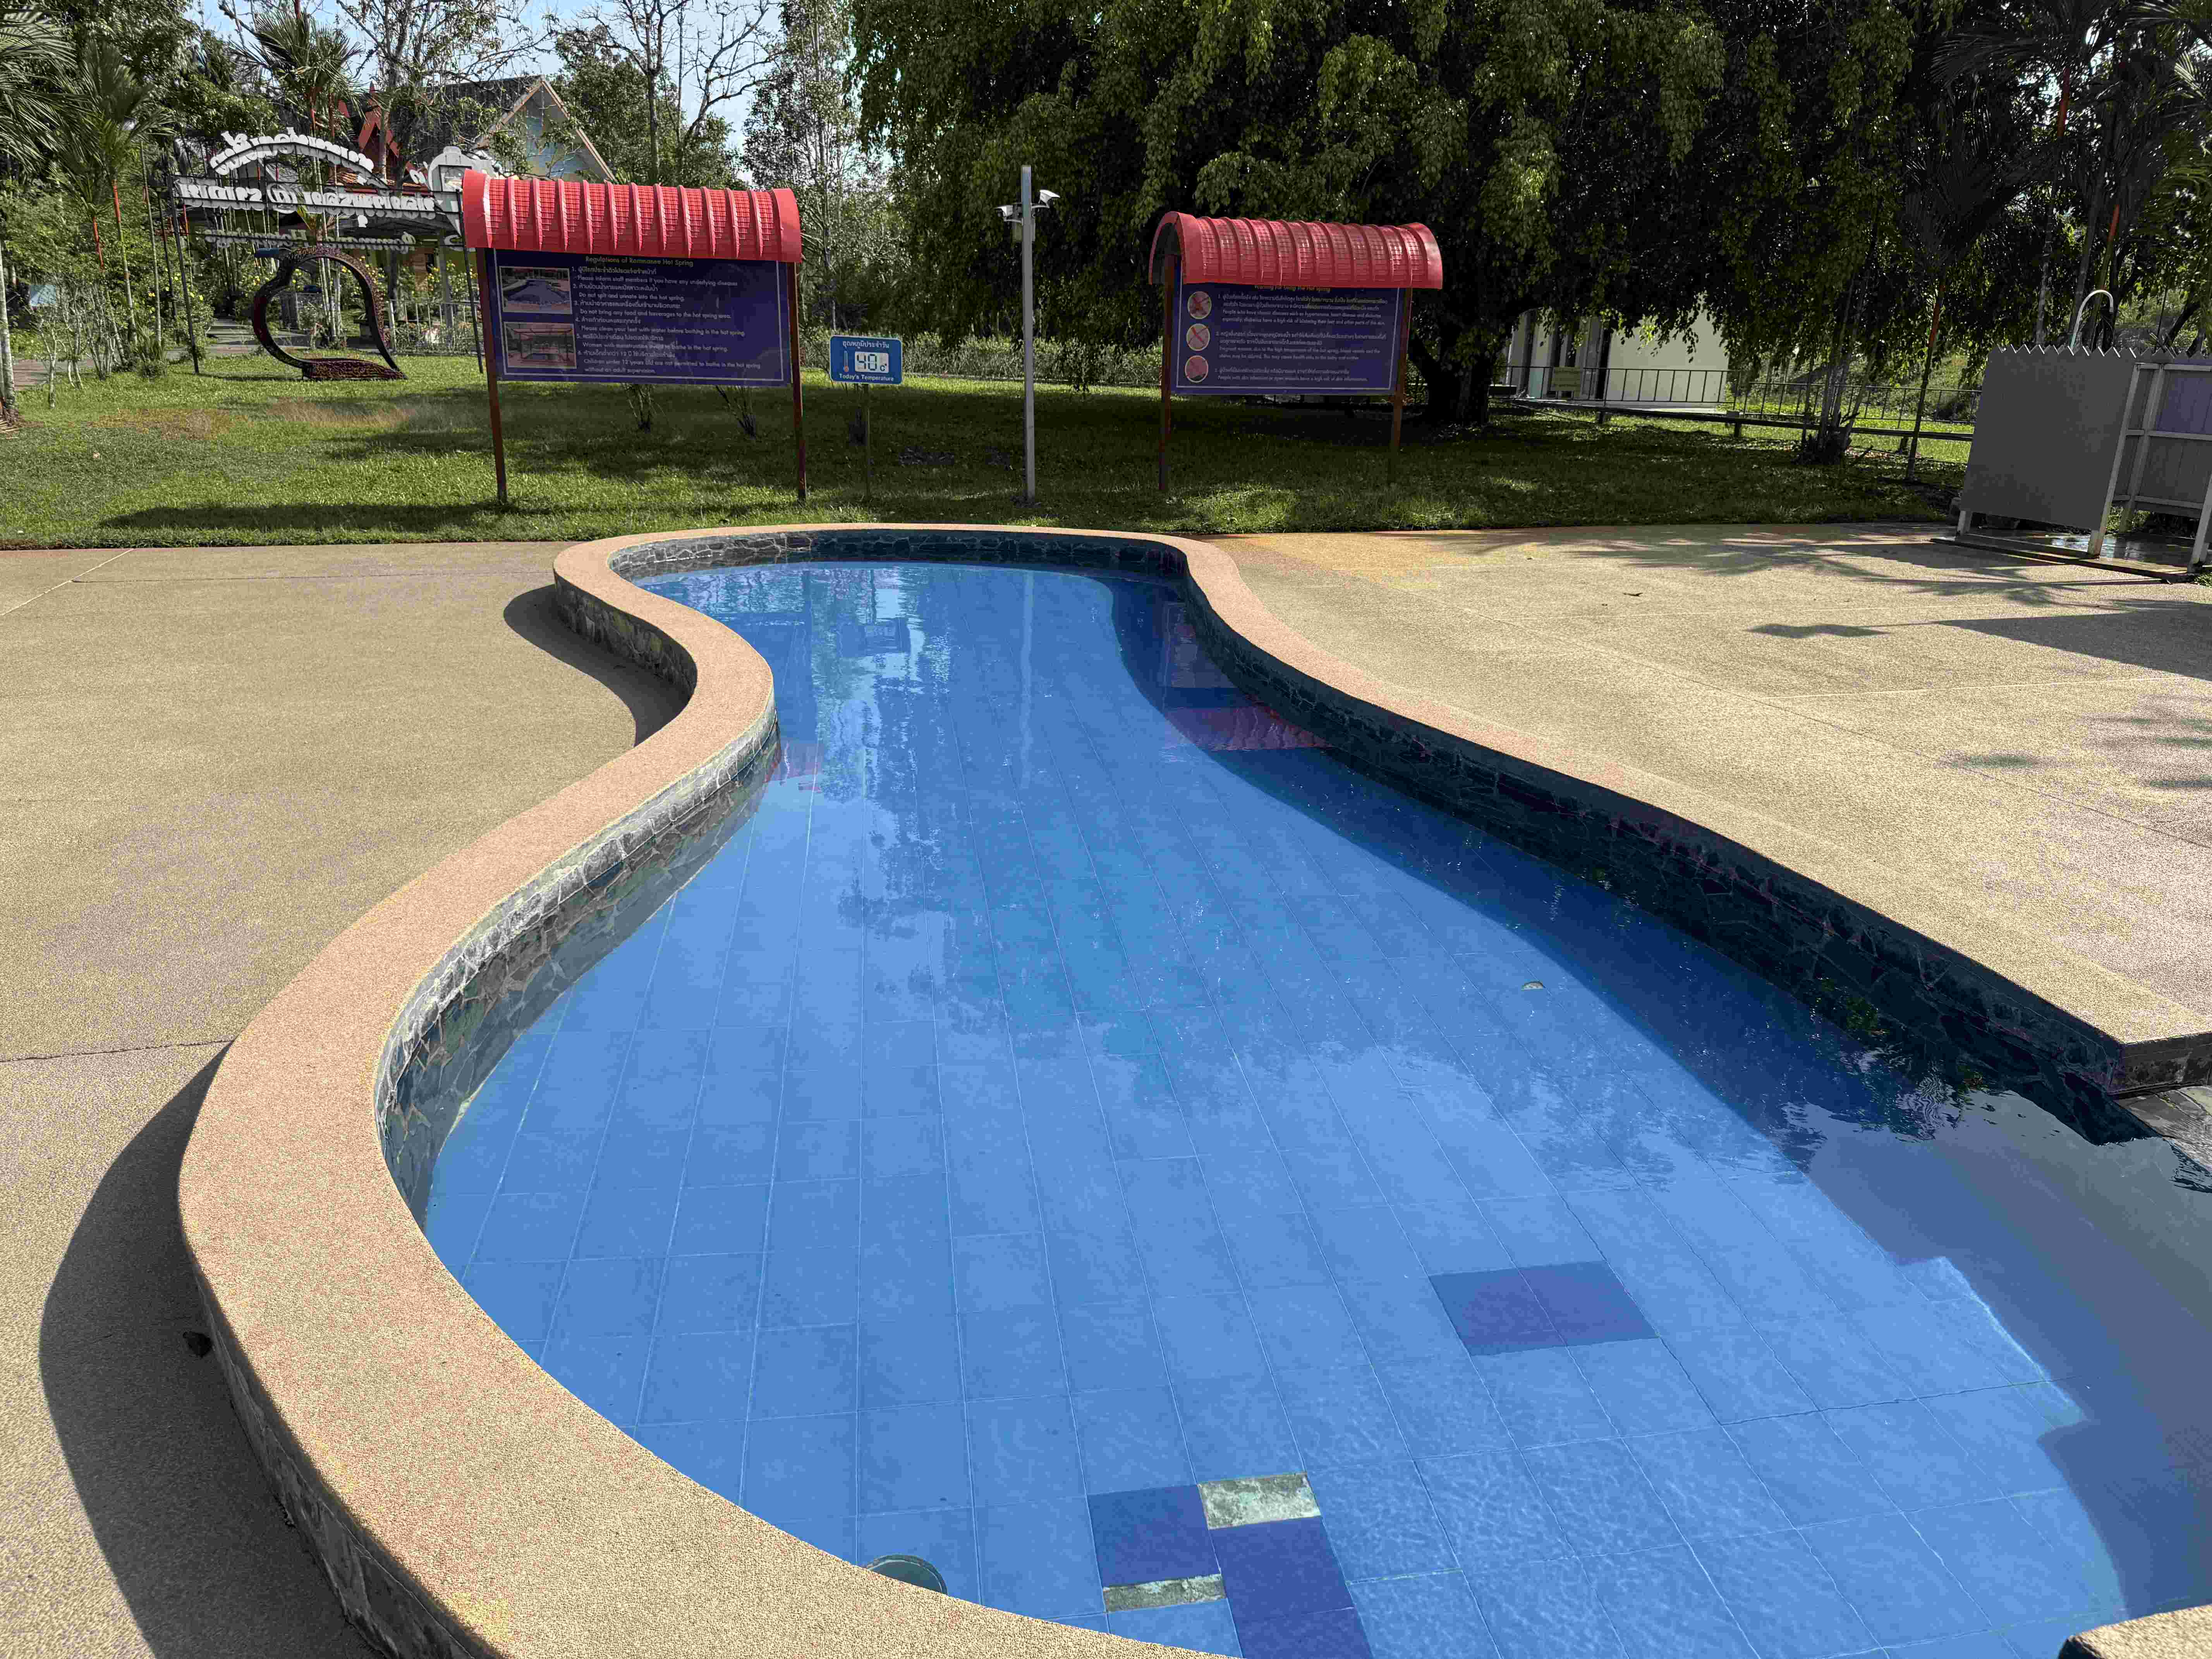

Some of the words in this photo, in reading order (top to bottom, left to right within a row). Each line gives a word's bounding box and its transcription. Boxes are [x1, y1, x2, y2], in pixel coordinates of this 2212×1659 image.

[843, 340, 889, 349] อุณหภูมิประจำวัน
